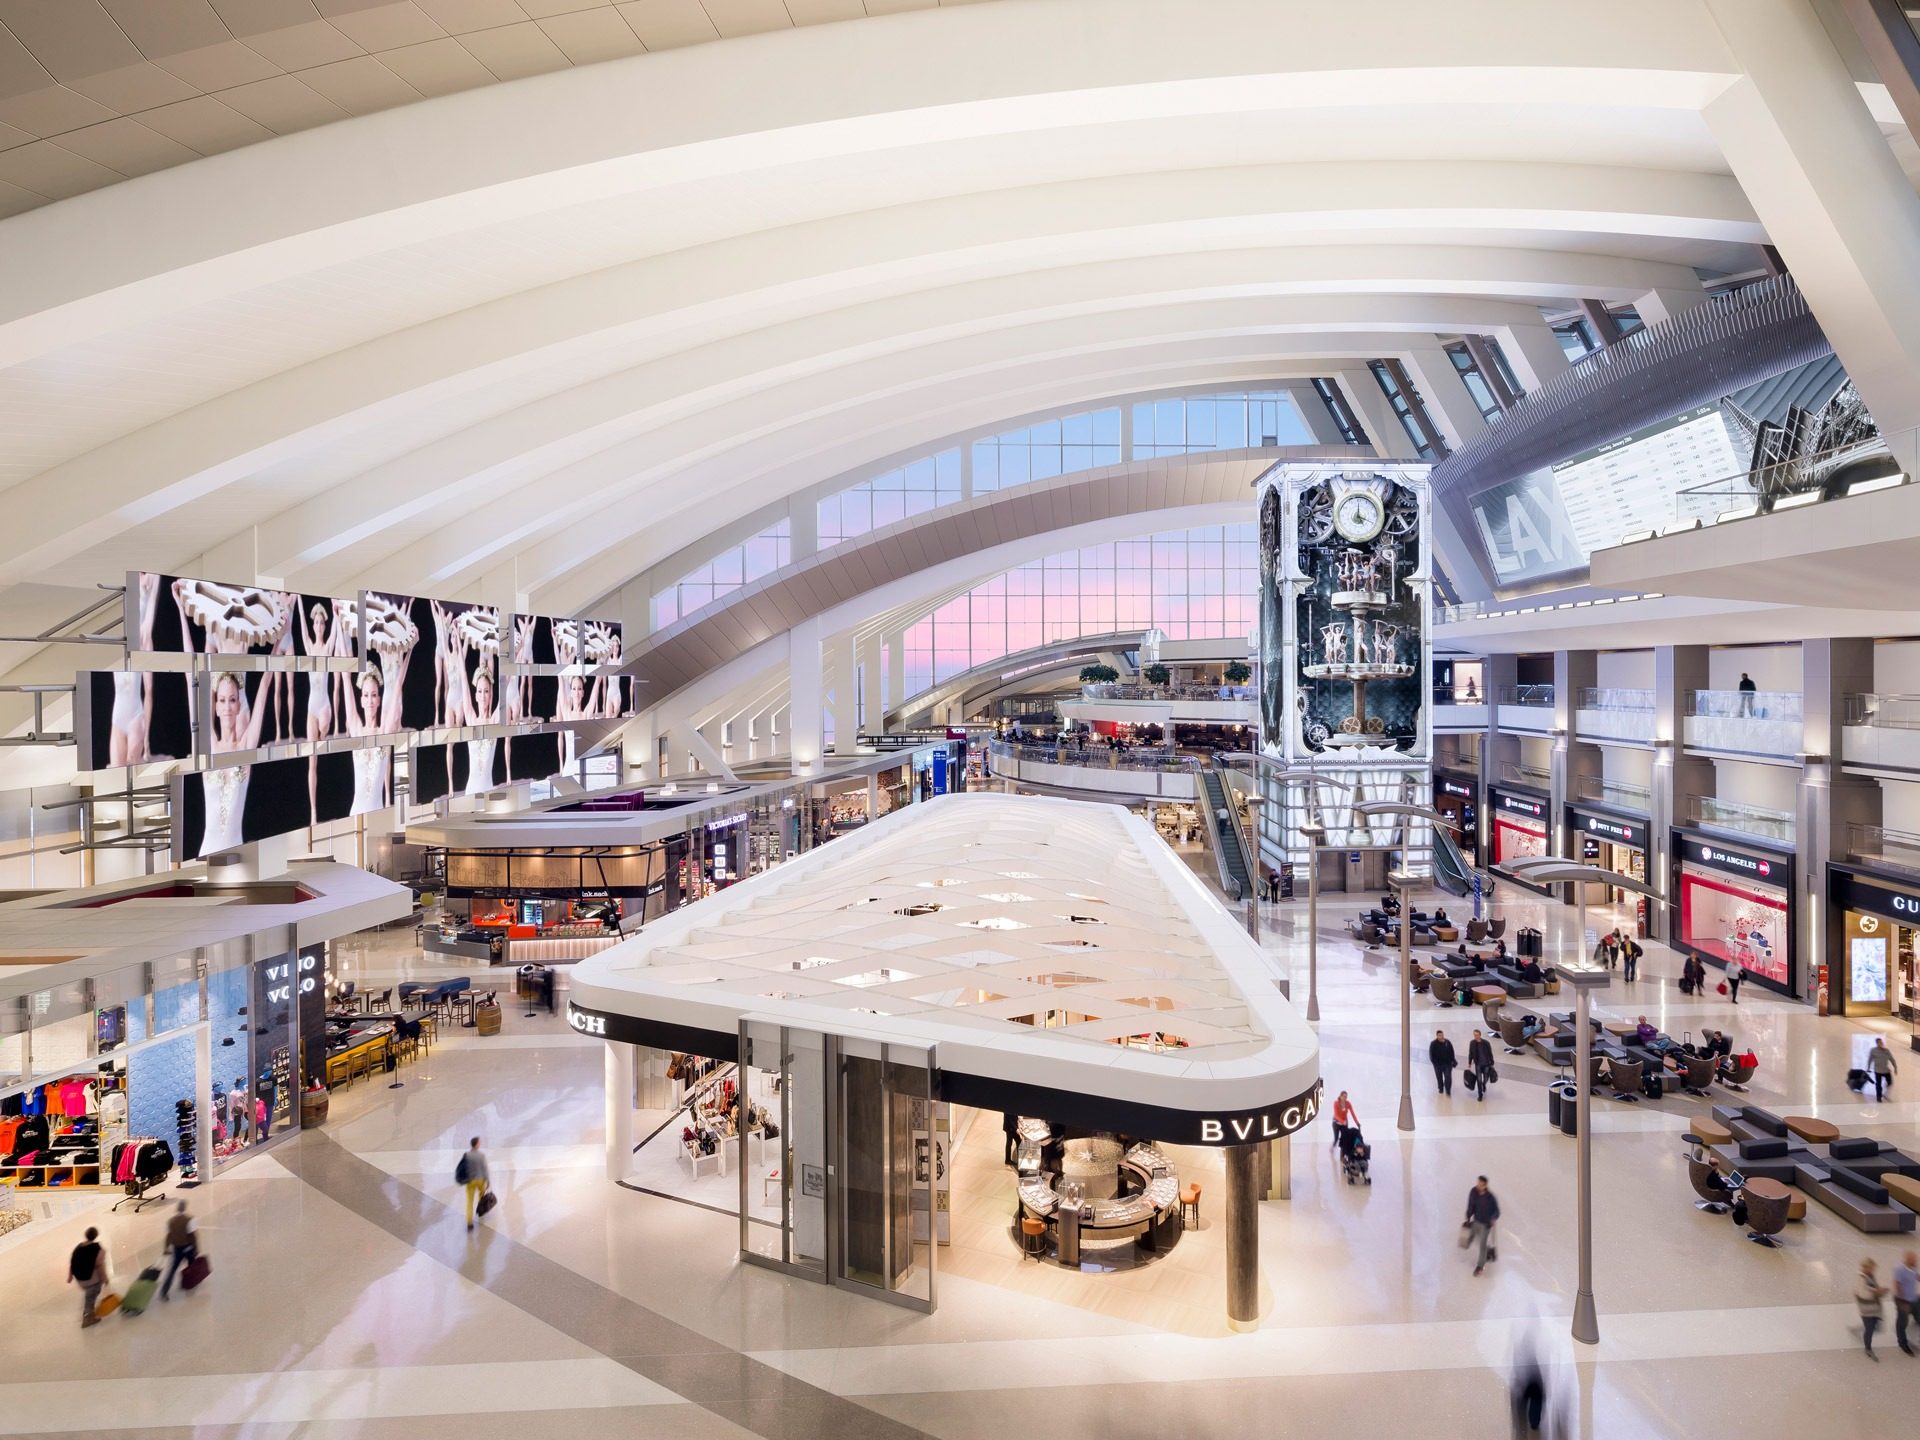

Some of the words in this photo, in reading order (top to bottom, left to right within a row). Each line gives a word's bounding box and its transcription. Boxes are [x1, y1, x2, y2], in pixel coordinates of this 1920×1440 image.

[1475, 486, 1578, 574] LAX
[1597, 822, 1610, 831] DUTY
[1610, 826, 1624, 835] FREE
[1713, 852, 1726, 862] LOS
[1726, 856, 1757, 870] ANGELES
[1893, 896, 1919, 913] GU
[266, 977, 316, 1003] VOO
